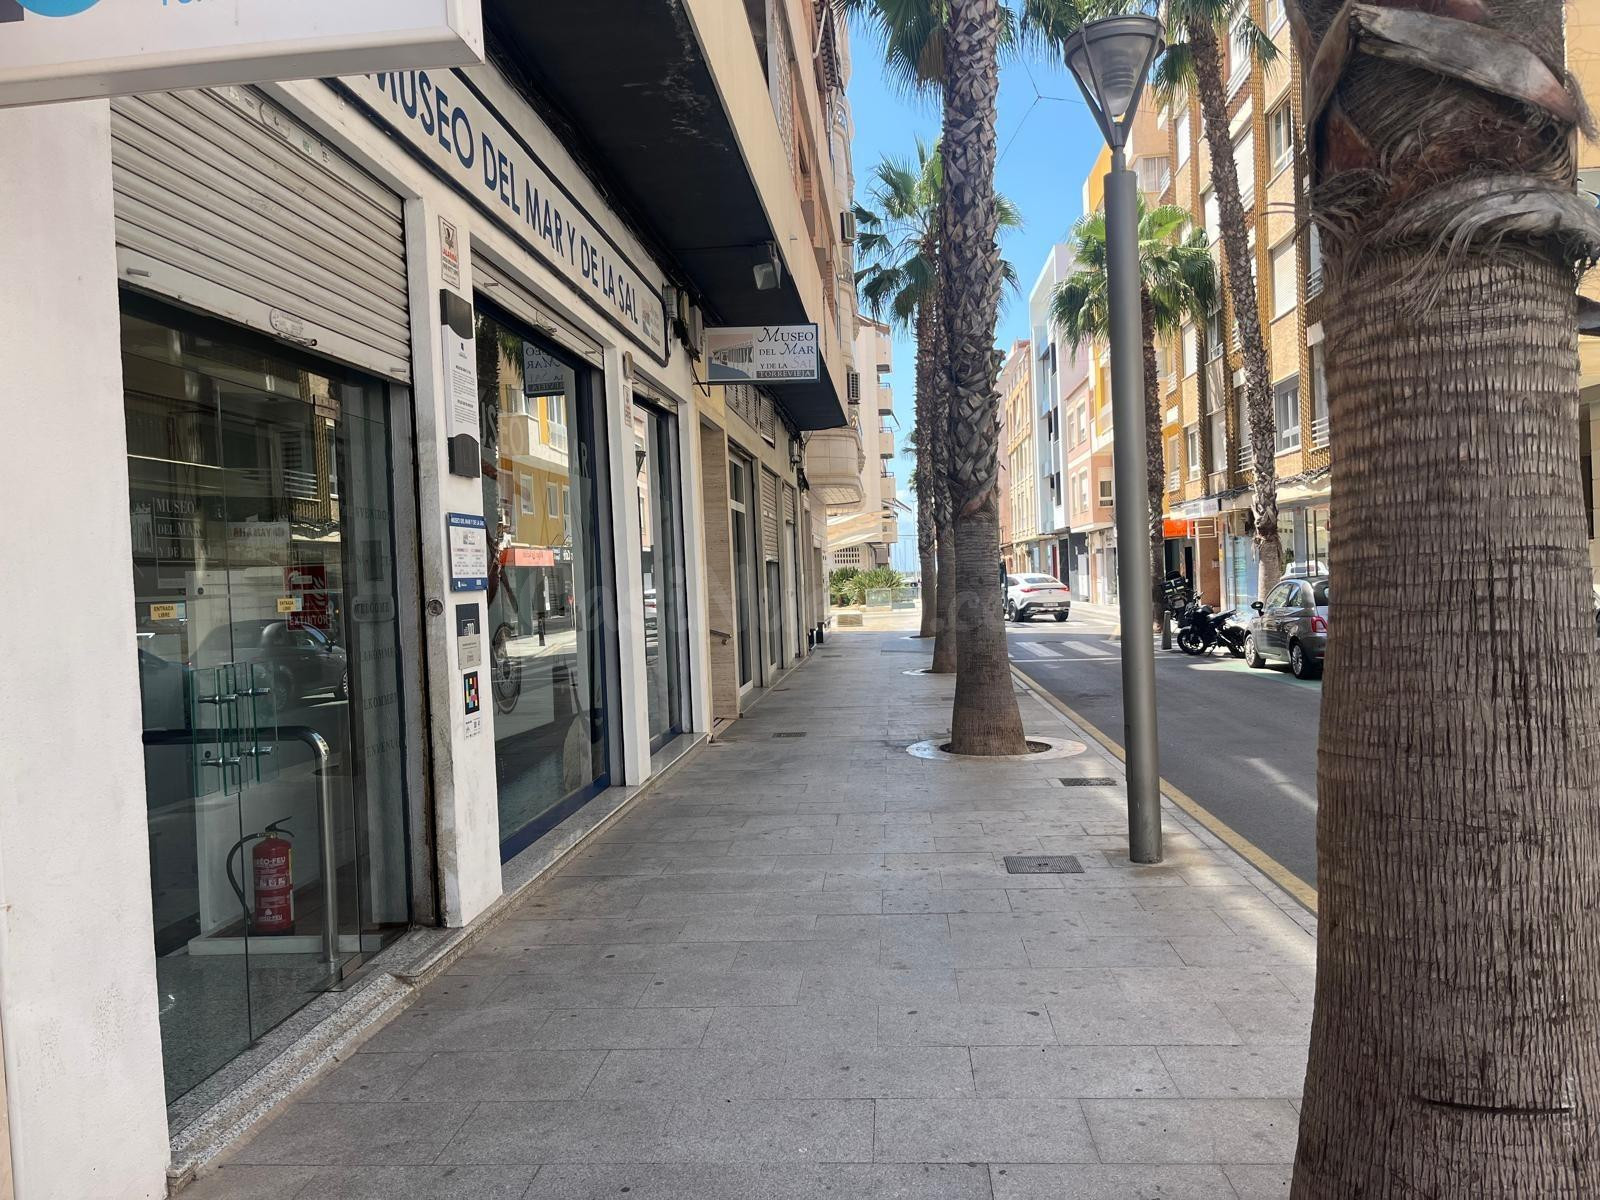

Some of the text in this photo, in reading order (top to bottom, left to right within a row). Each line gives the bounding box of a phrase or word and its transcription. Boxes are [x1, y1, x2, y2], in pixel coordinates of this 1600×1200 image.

[482, 131, 521, 217] DEL
[525, 178, 564, 257] MAR
[566, 219, 576, 266] Y
[580, 234, 599, 287] DE
[602, 255, 617, 305] LA
[618, 274, 639, 325] SAL
[757, 327, 814, 343] MUSEO
[759, 342, 815, 356] DEL MAR
[790, 357, 814, 369] SAL
[156, 498, 195, 514] MUSEO
[289, 614, 329, 626] EXTINTOR
